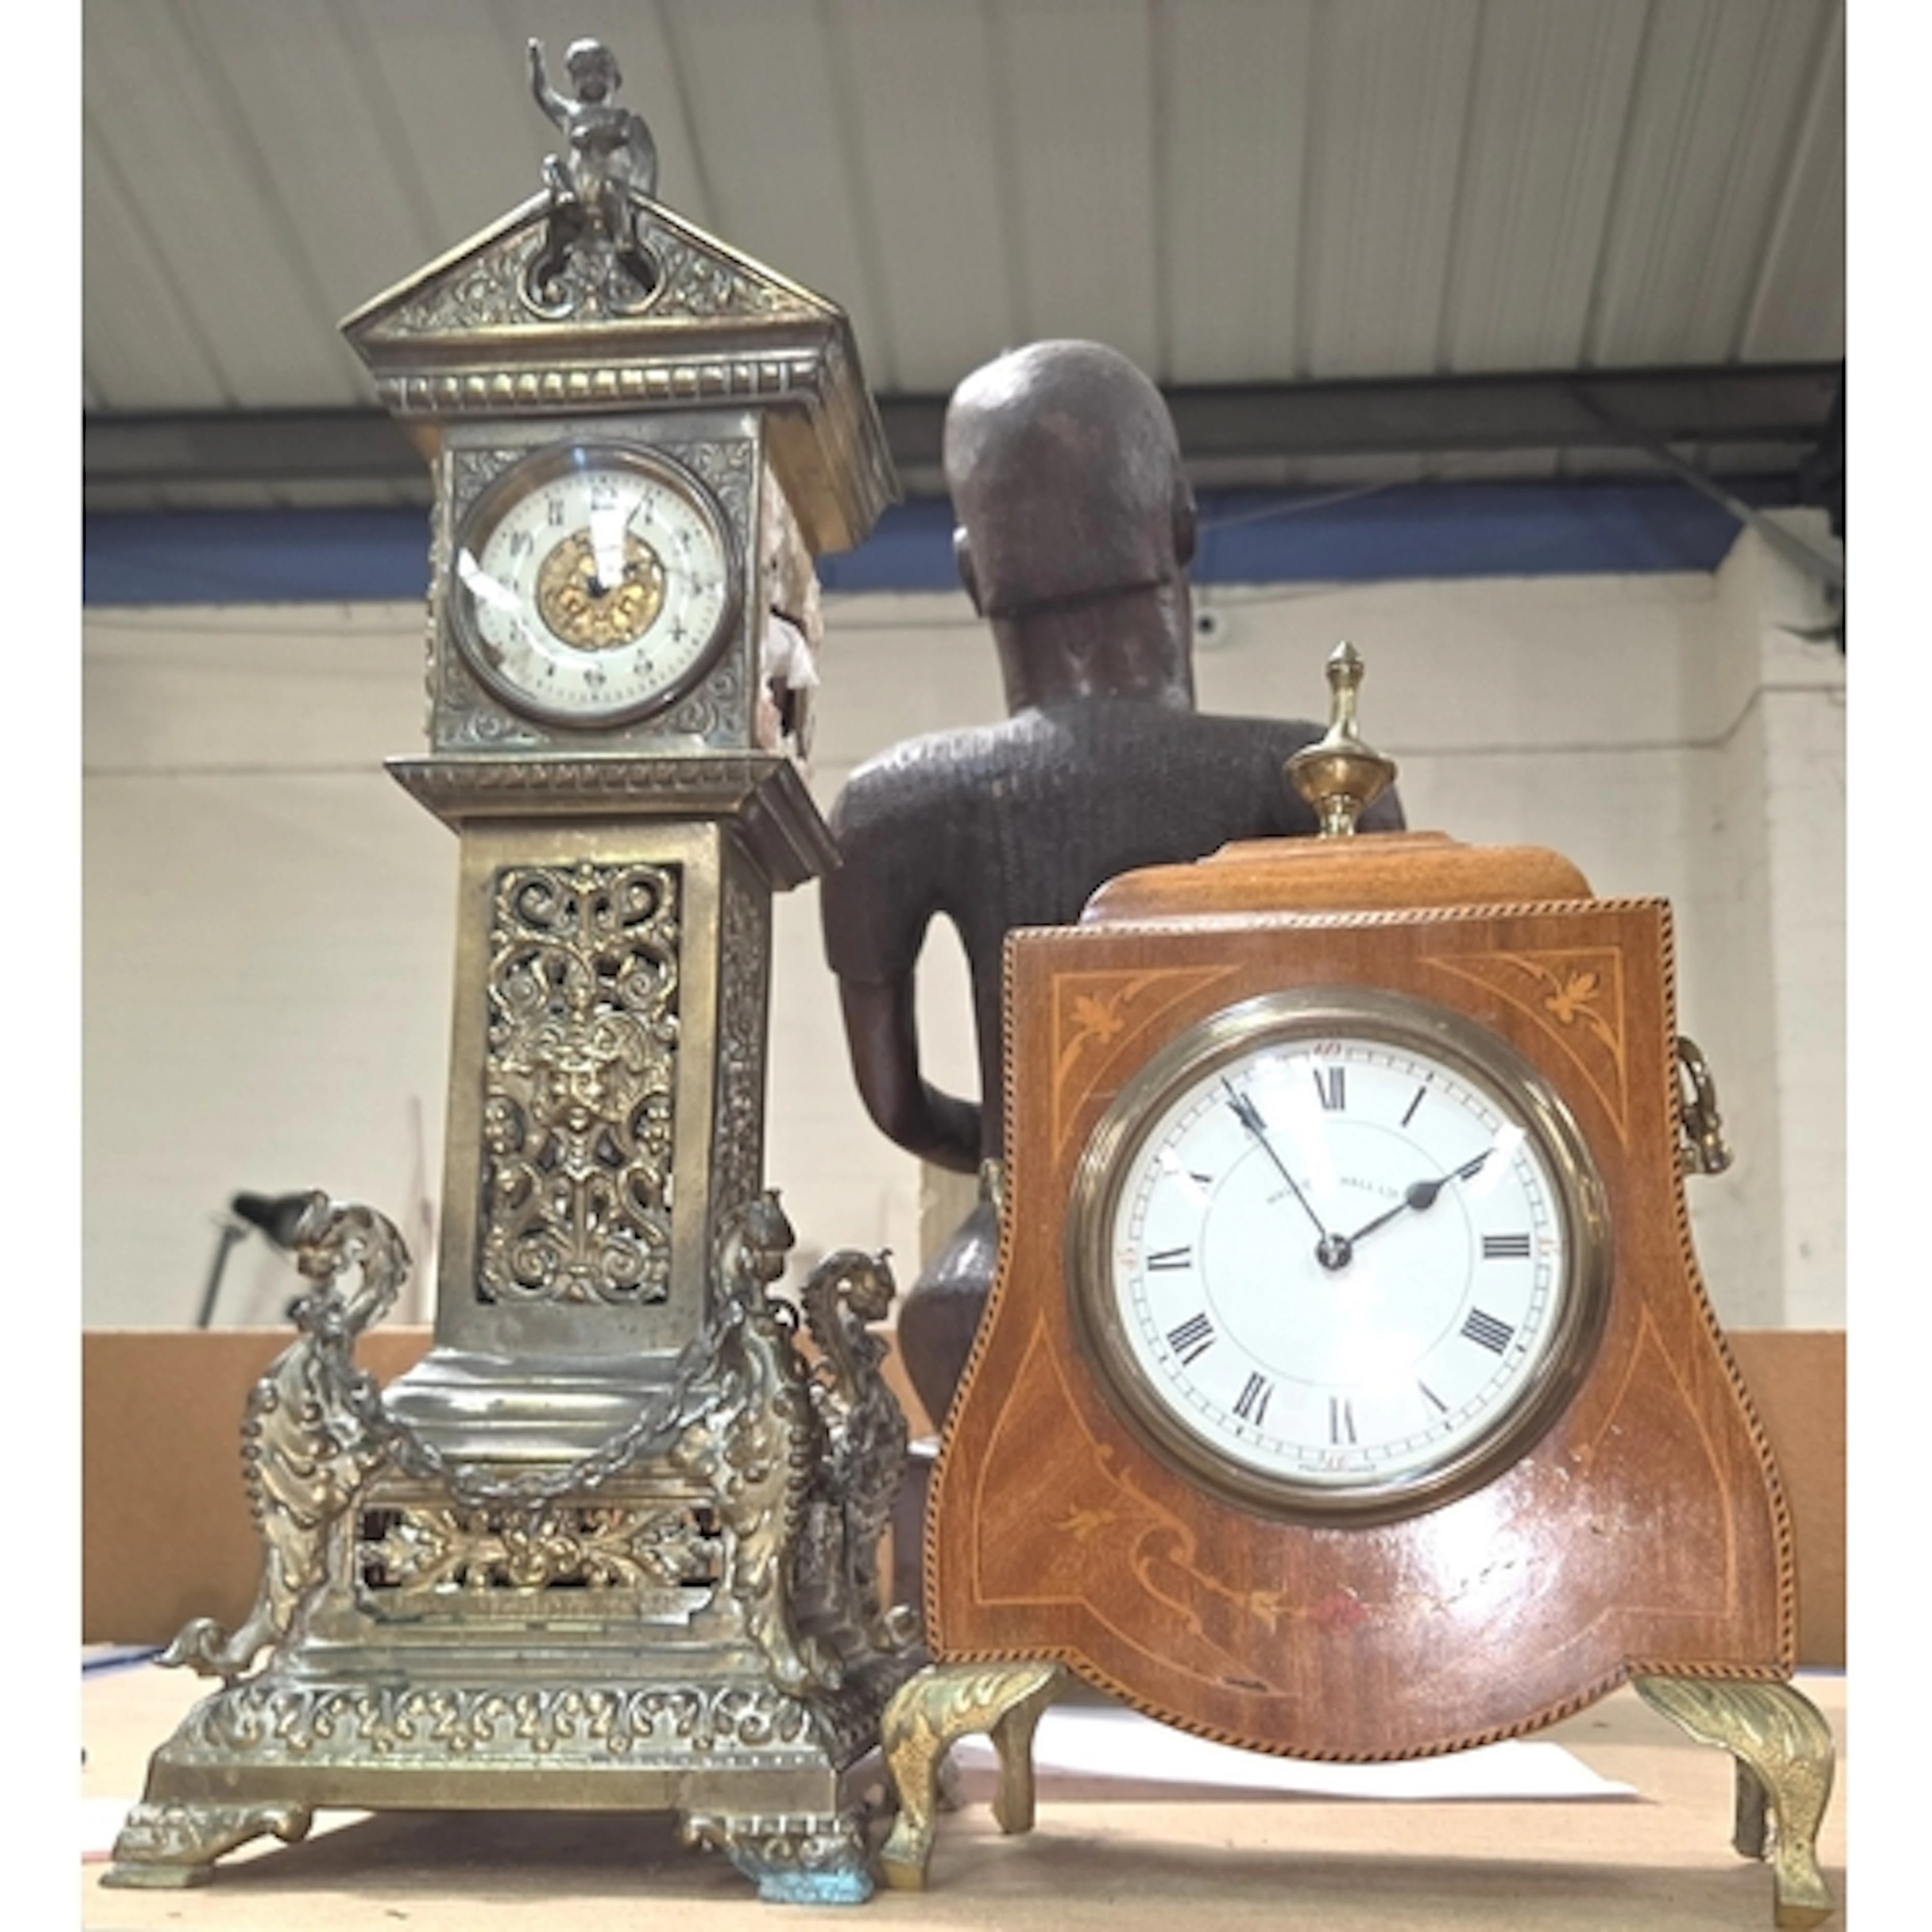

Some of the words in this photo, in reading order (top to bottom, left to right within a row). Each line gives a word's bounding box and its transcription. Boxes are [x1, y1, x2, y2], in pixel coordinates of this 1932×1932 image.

[1401, 1086, 1427, 1127] I
[1483, 1233, 1530, 1258] III
[1167, 1312, 1215, 1366] VIII
[1460, 1306, 1514, 1355] IIII
[1233, 1372, 1275, 1425] VII
